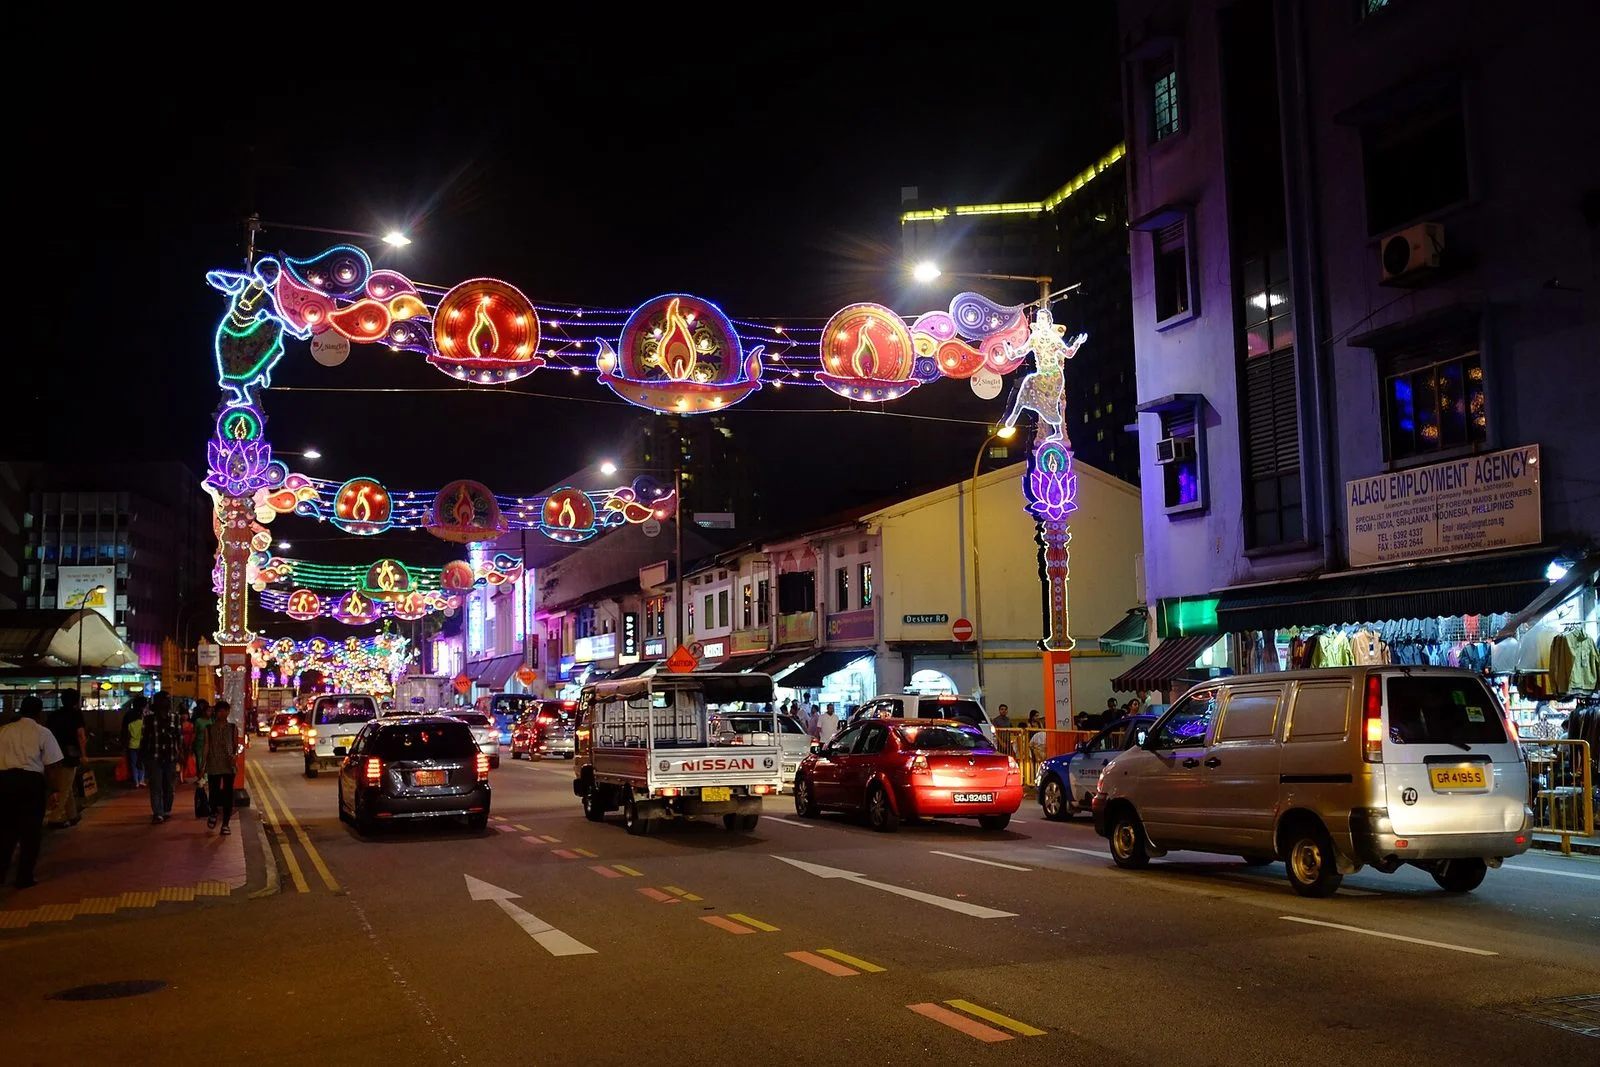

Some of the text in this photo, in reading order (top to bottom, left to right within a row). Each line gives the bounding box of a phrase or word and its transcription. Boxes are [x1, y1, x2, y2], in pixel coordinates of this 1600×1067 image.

[1351, 450, 1529, 507] ALAGU EMPLOYMENT AGENCY
[1355, 512, 1385, 524] SPECIALIST
[1437, 503, 1444, 511] OF
[1446, 499, 1472, 509] FOREIGN
[1473, 494, 1493, 504] MAIDS
[1500, 488, 1533, 500] WORKERS
[1355, 523, 1373, 534] FROM
[1377, 533, 1388, 542] TEL
[1393, 530, 1408, 540] 6392
[1408, 528, 1423, 538] 4337
[1377, 543, 1389, 552] FAX
[1393, 541, 1408, 550] 6392
[1408, 538, 1424, 548] 2644
[906, 615, 933, 623] Desker
[682, 758, 754, 772] NISSAN
[1437, 772, 1482, 784] GR 4195 S
[1404, 789, 1417, 801] 70
